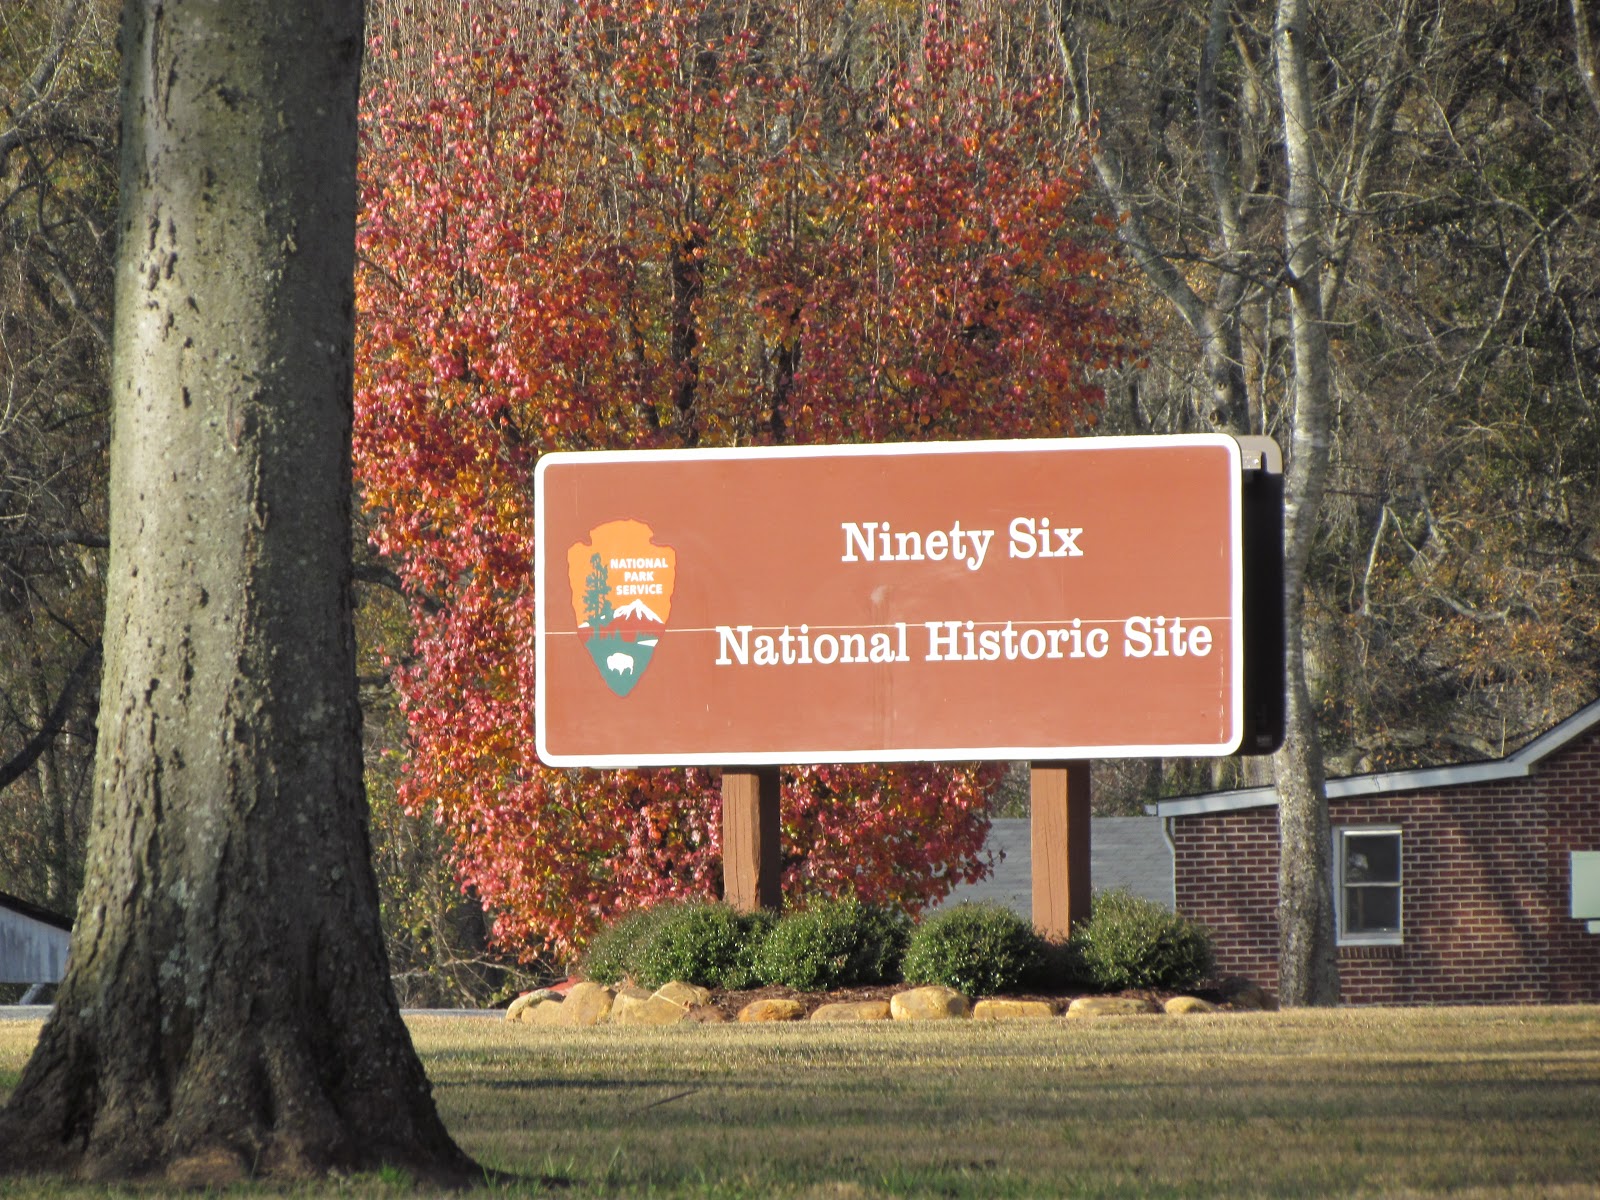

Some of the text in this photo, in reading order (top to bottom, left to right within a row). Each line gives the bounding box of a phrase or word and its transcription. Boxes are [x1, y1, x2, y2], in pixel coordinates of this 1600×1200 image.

[841, 516, 1084, 571] Ninety Six
[610, 558, 668, 569] NATIONAL
[624, 571, 654, 582] PARK
[616, 584, 663, 596] SERVICE
[715, 615, 1213, 666] National Historic Site
